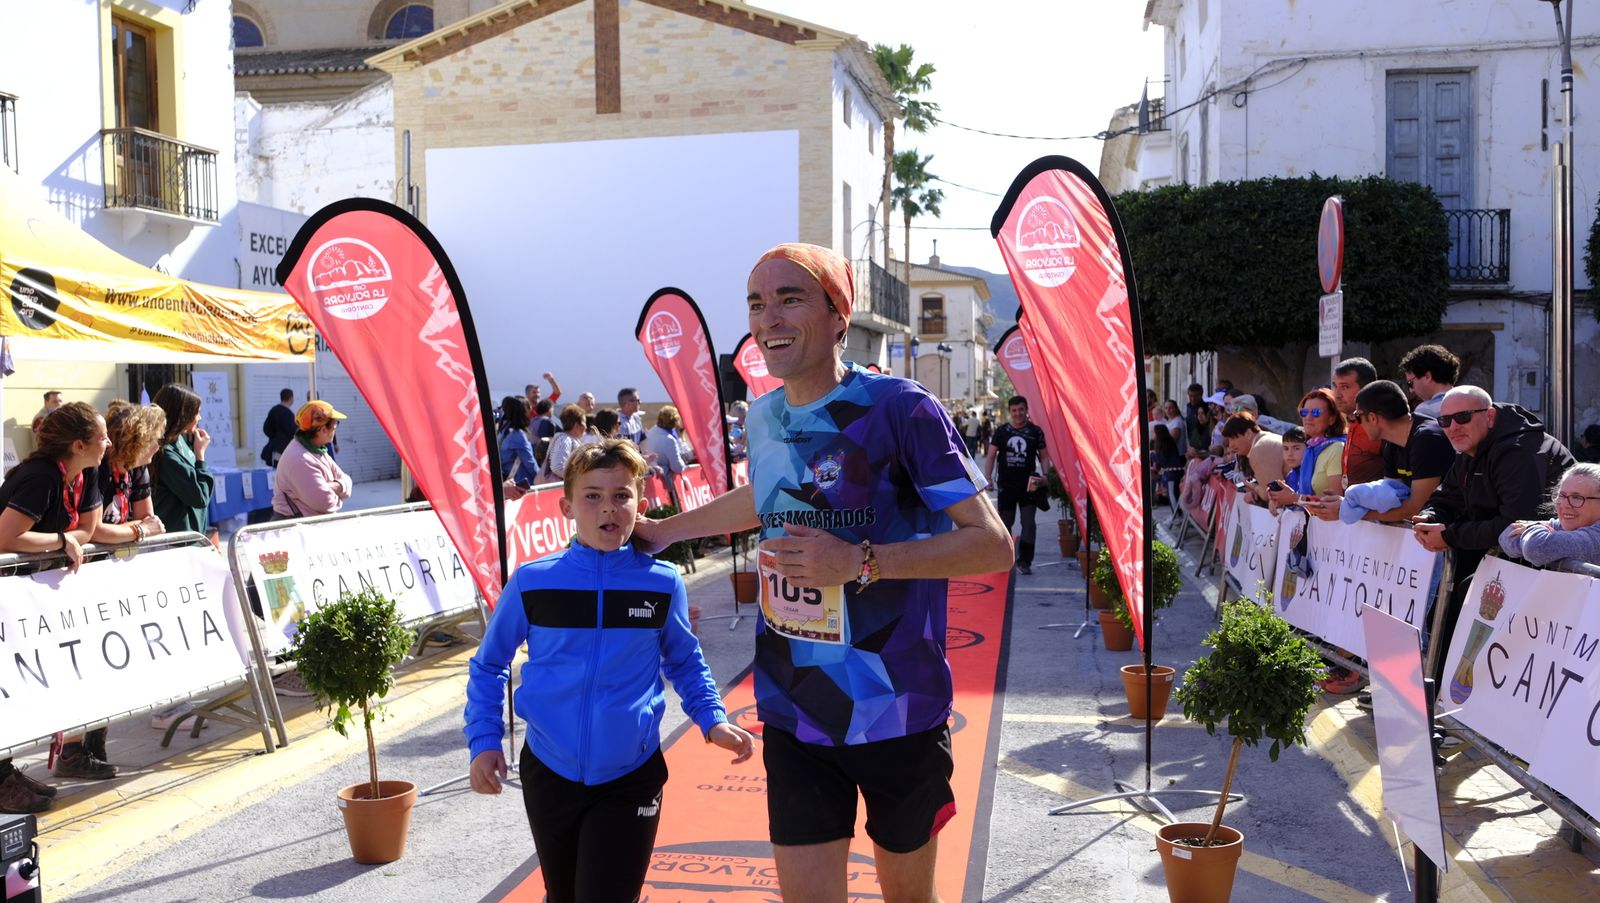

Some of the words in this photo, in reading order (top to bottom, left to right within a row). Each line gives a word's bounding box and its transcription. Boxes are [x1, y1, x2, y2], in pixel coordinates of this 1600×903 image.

[312, 553, 466, 611] CANTORIA
[768, 572, 823, 606] 105
[1396, 566, 1418, 589] DE
[179, 582, 207, 604] DE
[628, 608, 652, 618] PUMA
[0, 609, 224, 699] NTORIA
[653, 853, 749, 864] Cantoria
